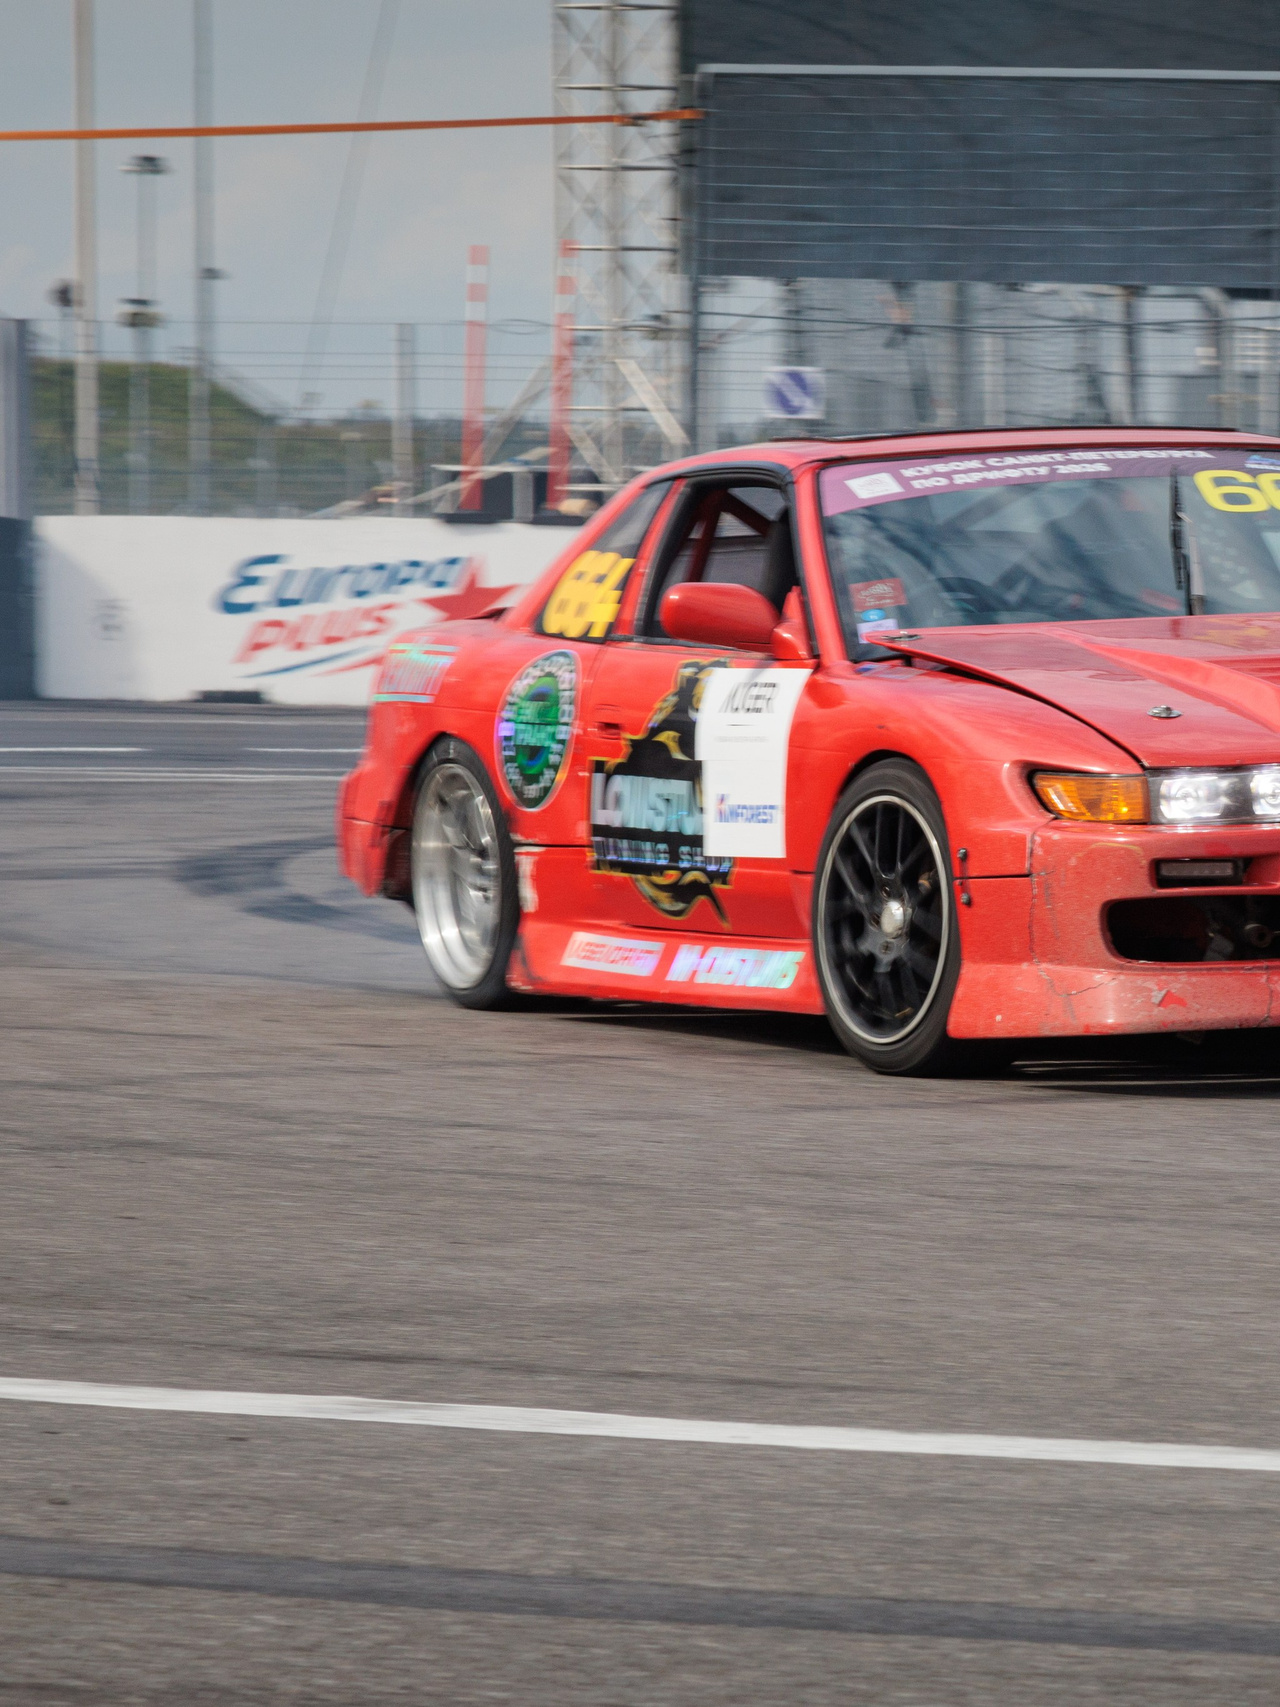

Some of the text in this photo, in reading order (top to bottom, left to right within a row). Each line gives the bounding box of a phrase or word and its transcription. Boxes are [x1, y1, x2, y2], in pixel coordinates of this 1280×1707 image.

[900, 460, 985, 477] КУБОК
[909, 476, 949, 489] ПО
[952, 465, 1051, 485] ДРИФТУ
[214, 554, 470, 615] Europa
